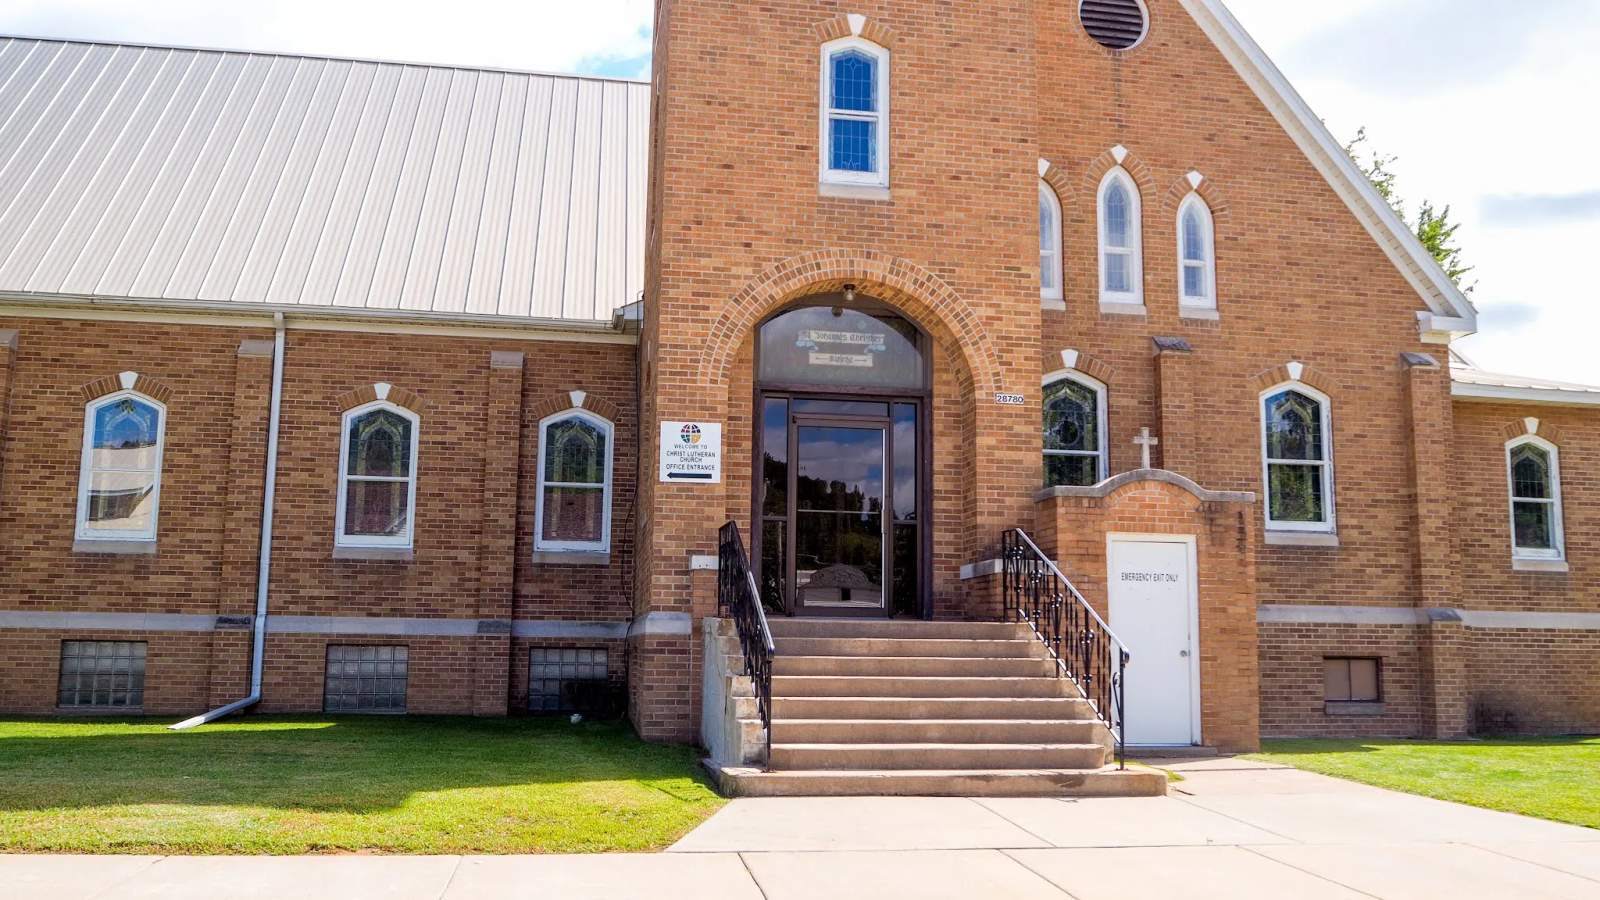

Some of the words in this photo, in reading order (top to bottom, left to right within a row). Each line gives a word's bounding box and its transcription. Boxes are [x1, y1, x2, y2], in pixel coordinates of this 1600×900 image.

[997, 395, 1024, 403] 28780
[1121, 572, 1152, 582] EMERGENCY
[1153, 573, 1164, 582] EXIT
[1165, 573, 1178, 582] ONLY
